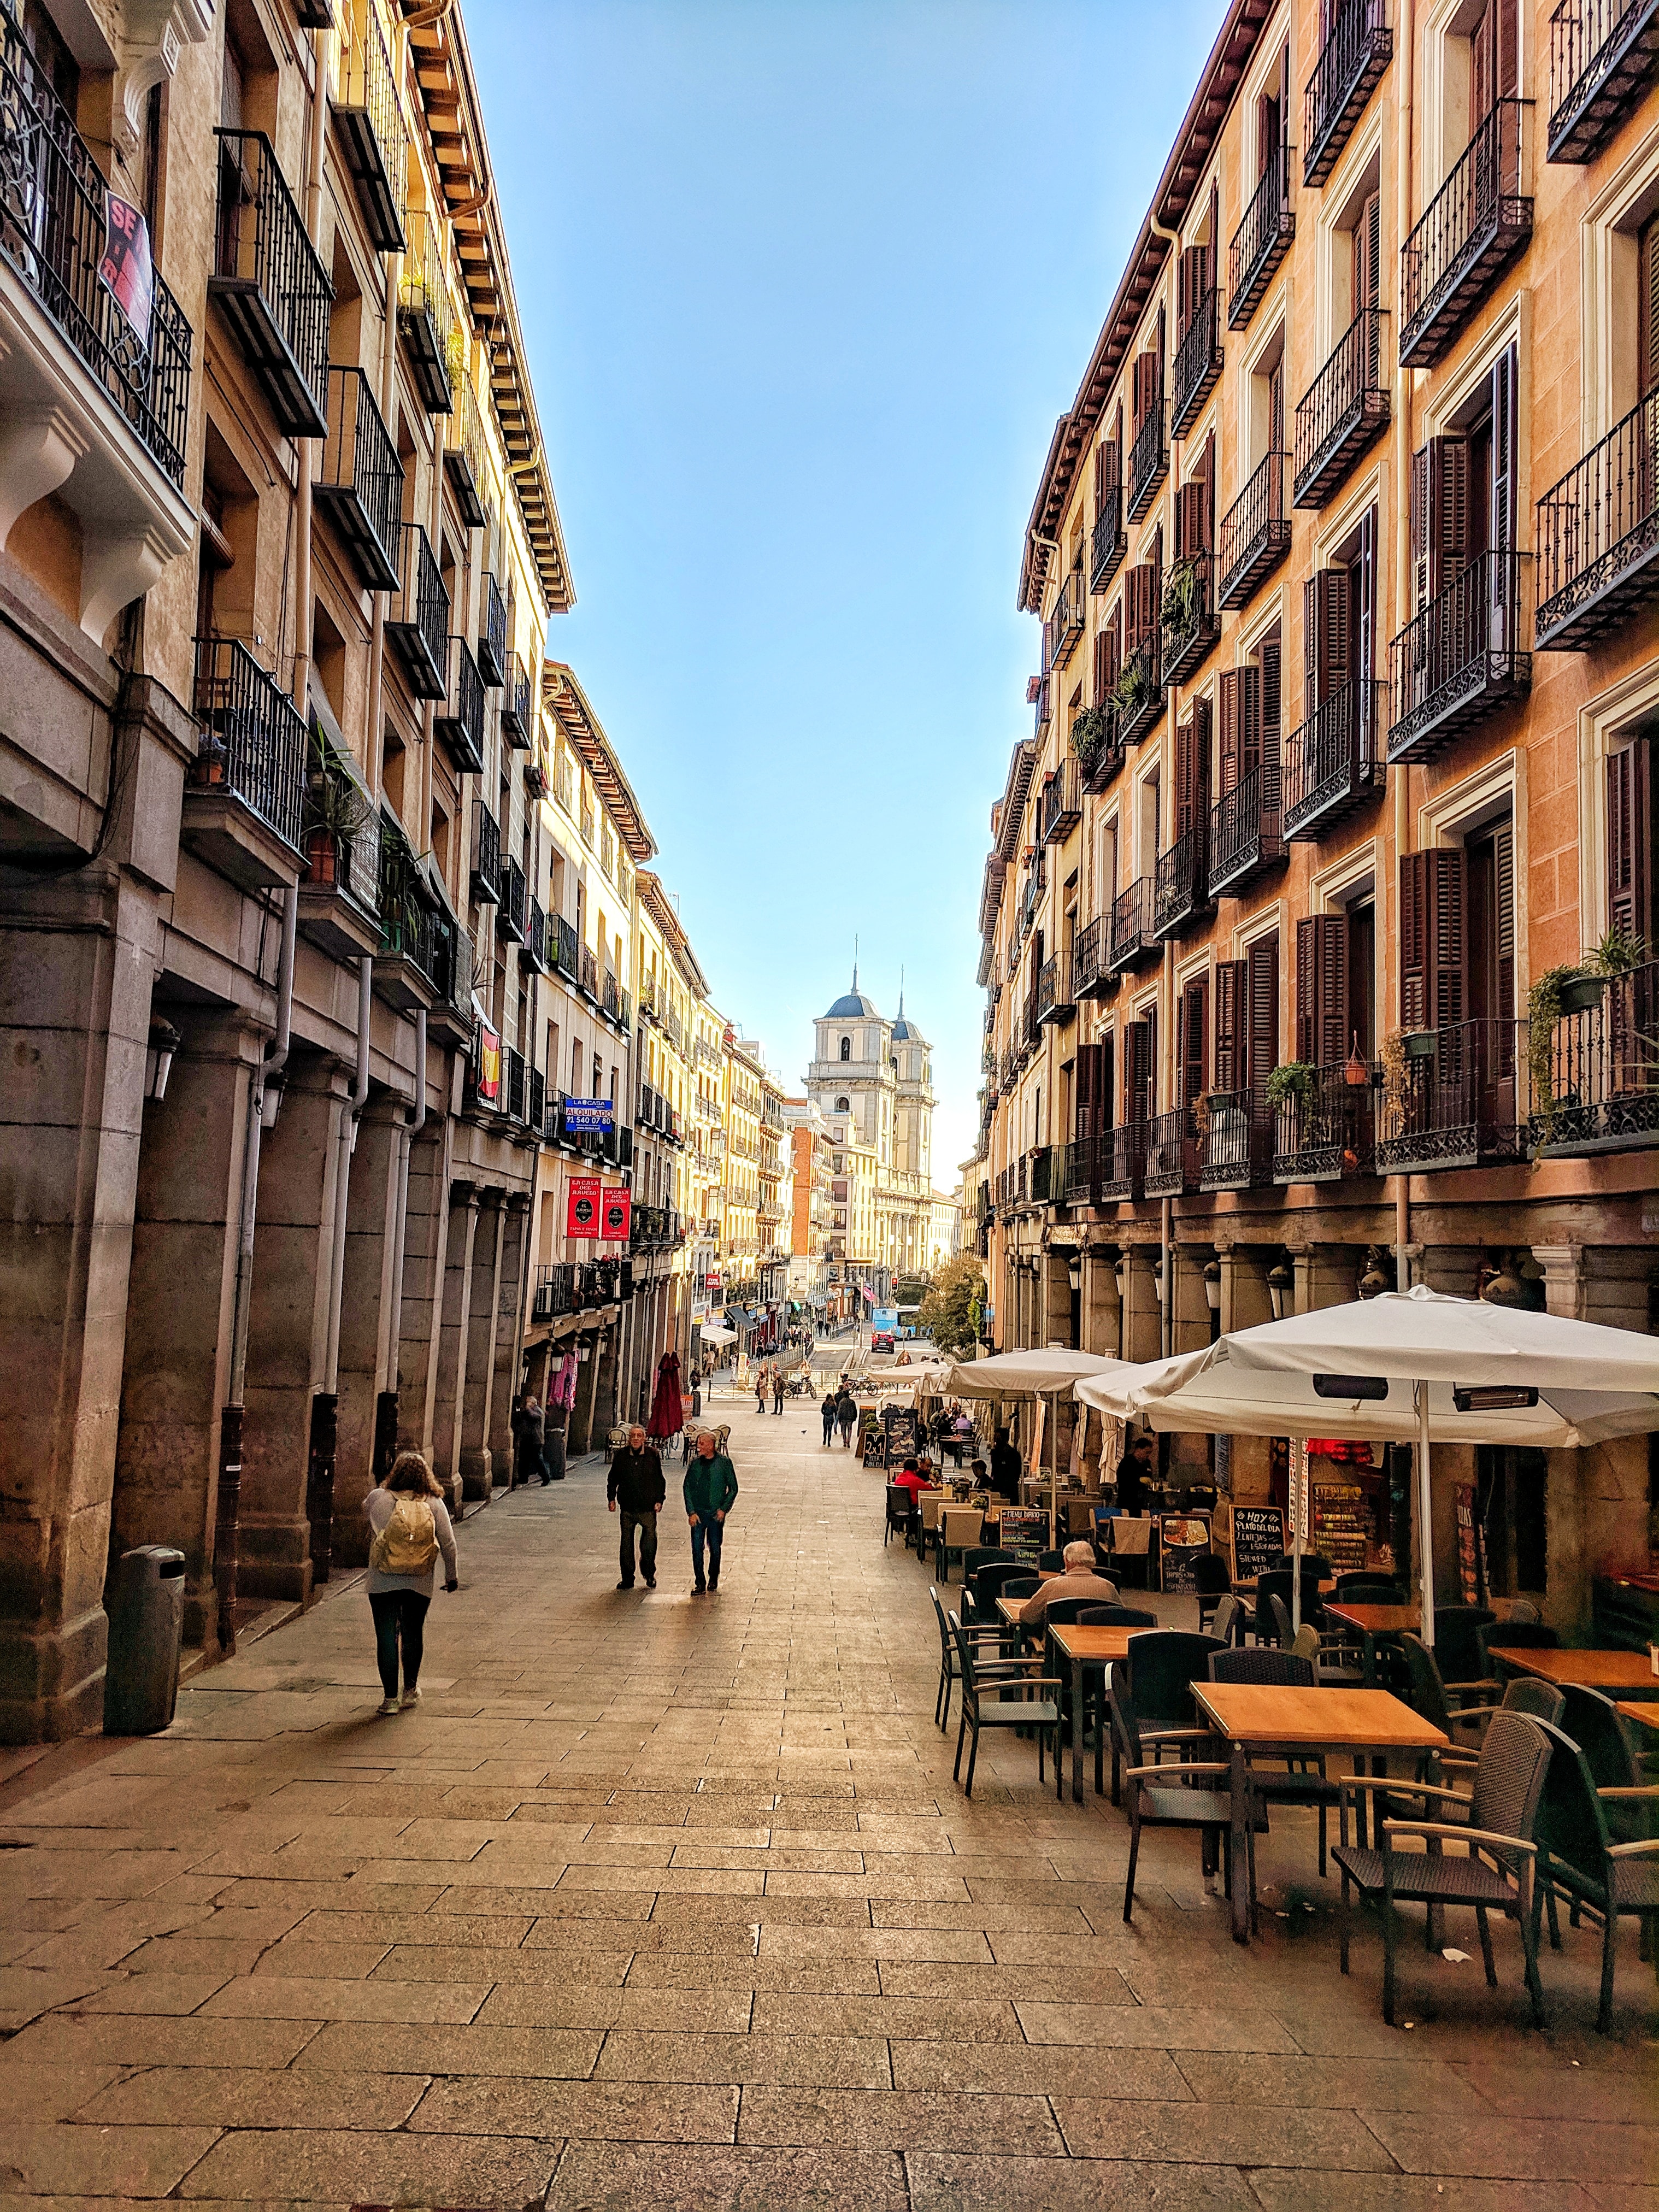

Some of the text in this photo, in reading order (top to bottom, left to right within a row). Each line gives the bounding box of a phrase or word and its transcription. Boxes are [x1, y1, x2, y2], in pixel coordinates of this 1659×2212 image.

[111, 200, 137, 240] SE
[567, 1108, 612, 1117] ALQUILADO
[1007, 1510, 1022, 1519] MENU
[1247, 1511, 1268, 1523] HOY
[1236, 1521, 1256, 1531] PLATO
[1256, 1523, 1267, 1532] DEL
[1239, 1554, 1267, 1563] STEWED
